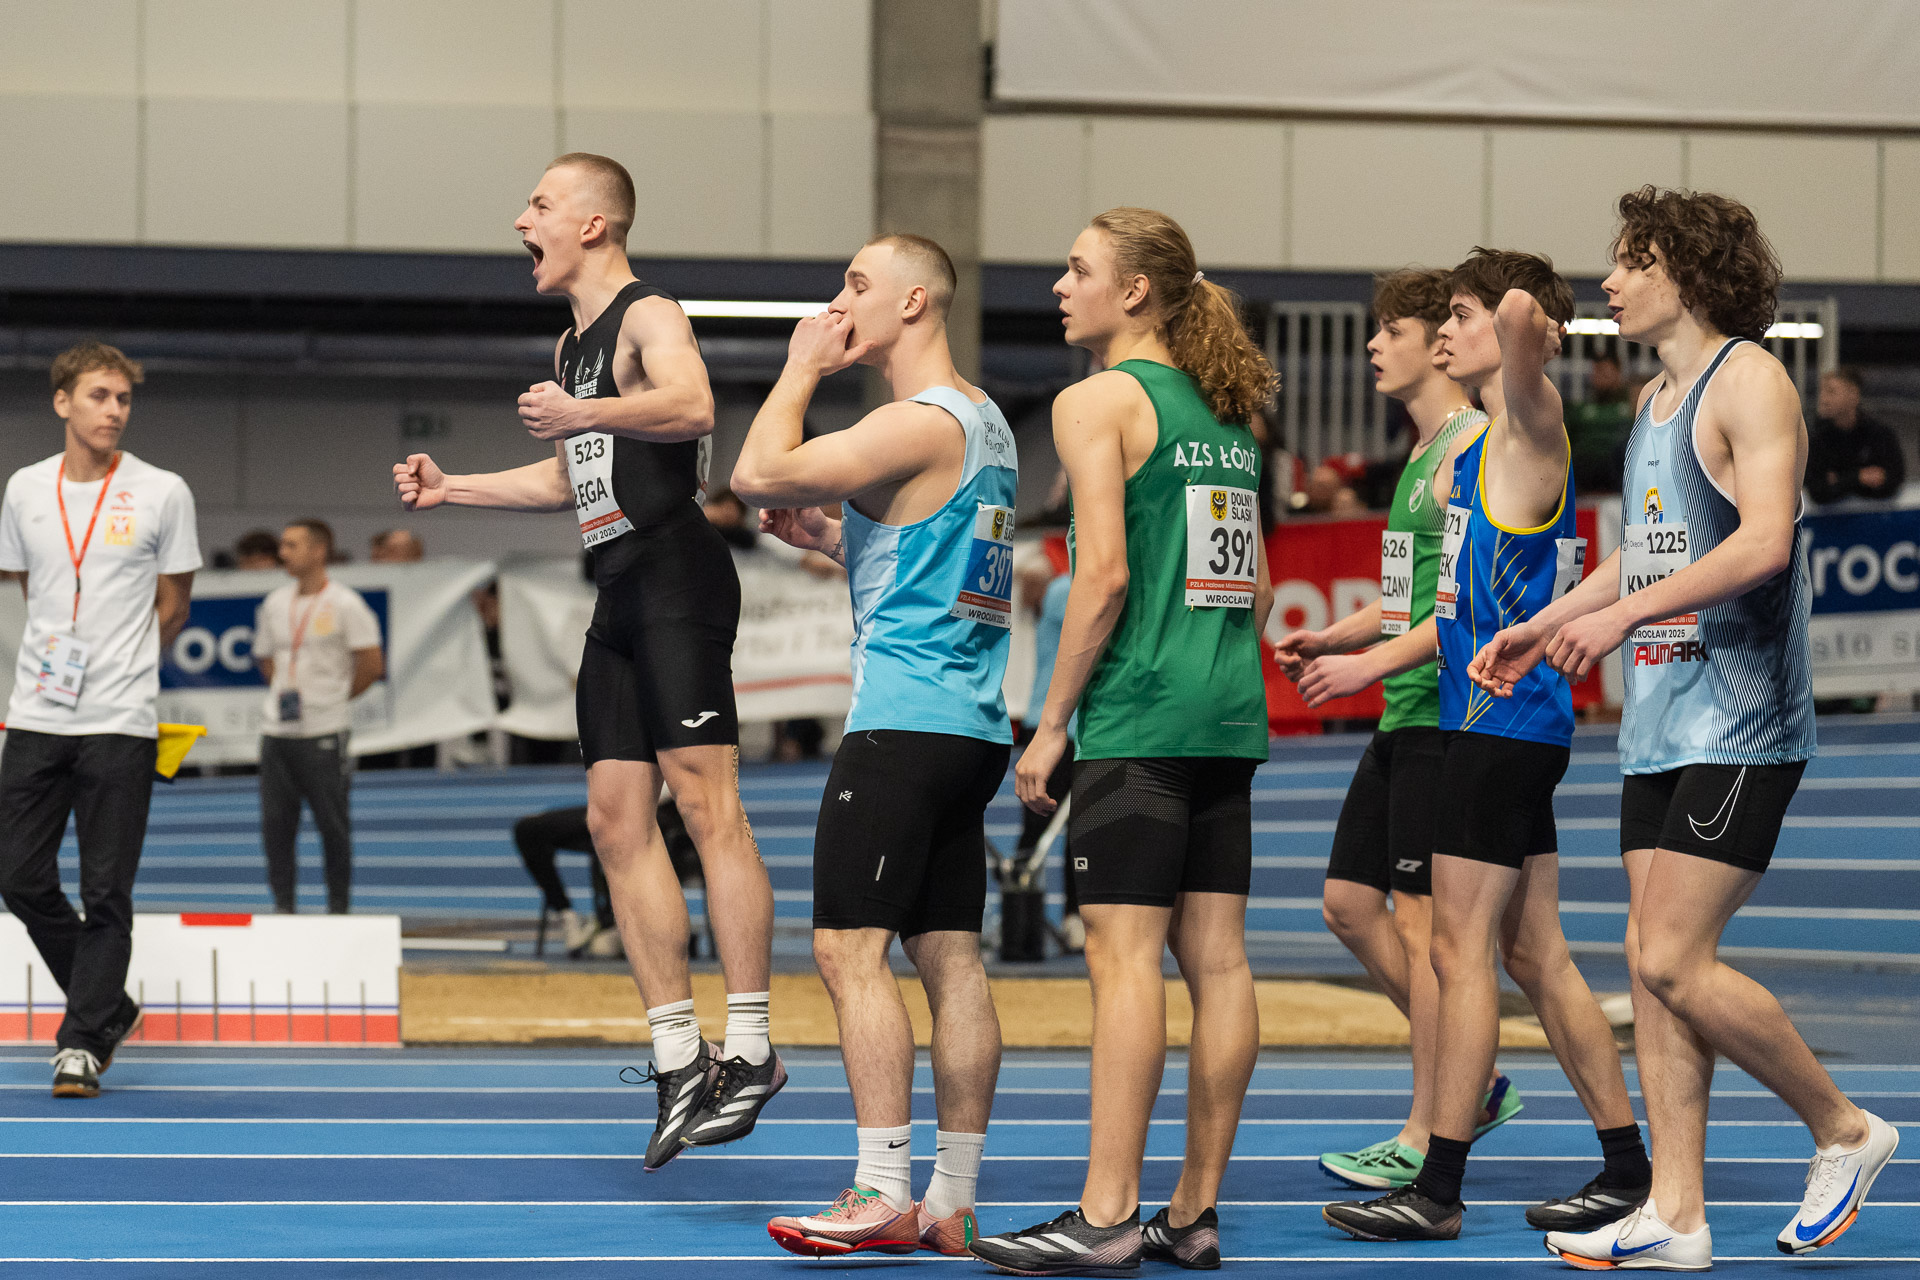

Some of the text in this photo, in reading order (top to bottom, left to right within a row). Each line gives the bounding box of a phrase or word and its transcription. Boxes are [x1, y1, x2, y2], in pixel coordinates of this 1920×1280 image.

[575, 438, 605, 465] 523
[1174, 440, 1256, 477] AZS ŁÓDŹ
[1231, 492, 1252, 507] DOLNY
[600, 526, 617, 539] 2025
[1647, 530, 1687, 554] 1225
[1208, 527, 1255, 578] 392
[1382, 539, 1407, 559] 626
[978, 545, 1013, 596] 397
[1206, 594, 1249, 605] WROCŁAW
[1668, 629, 1686, 638] 2025
